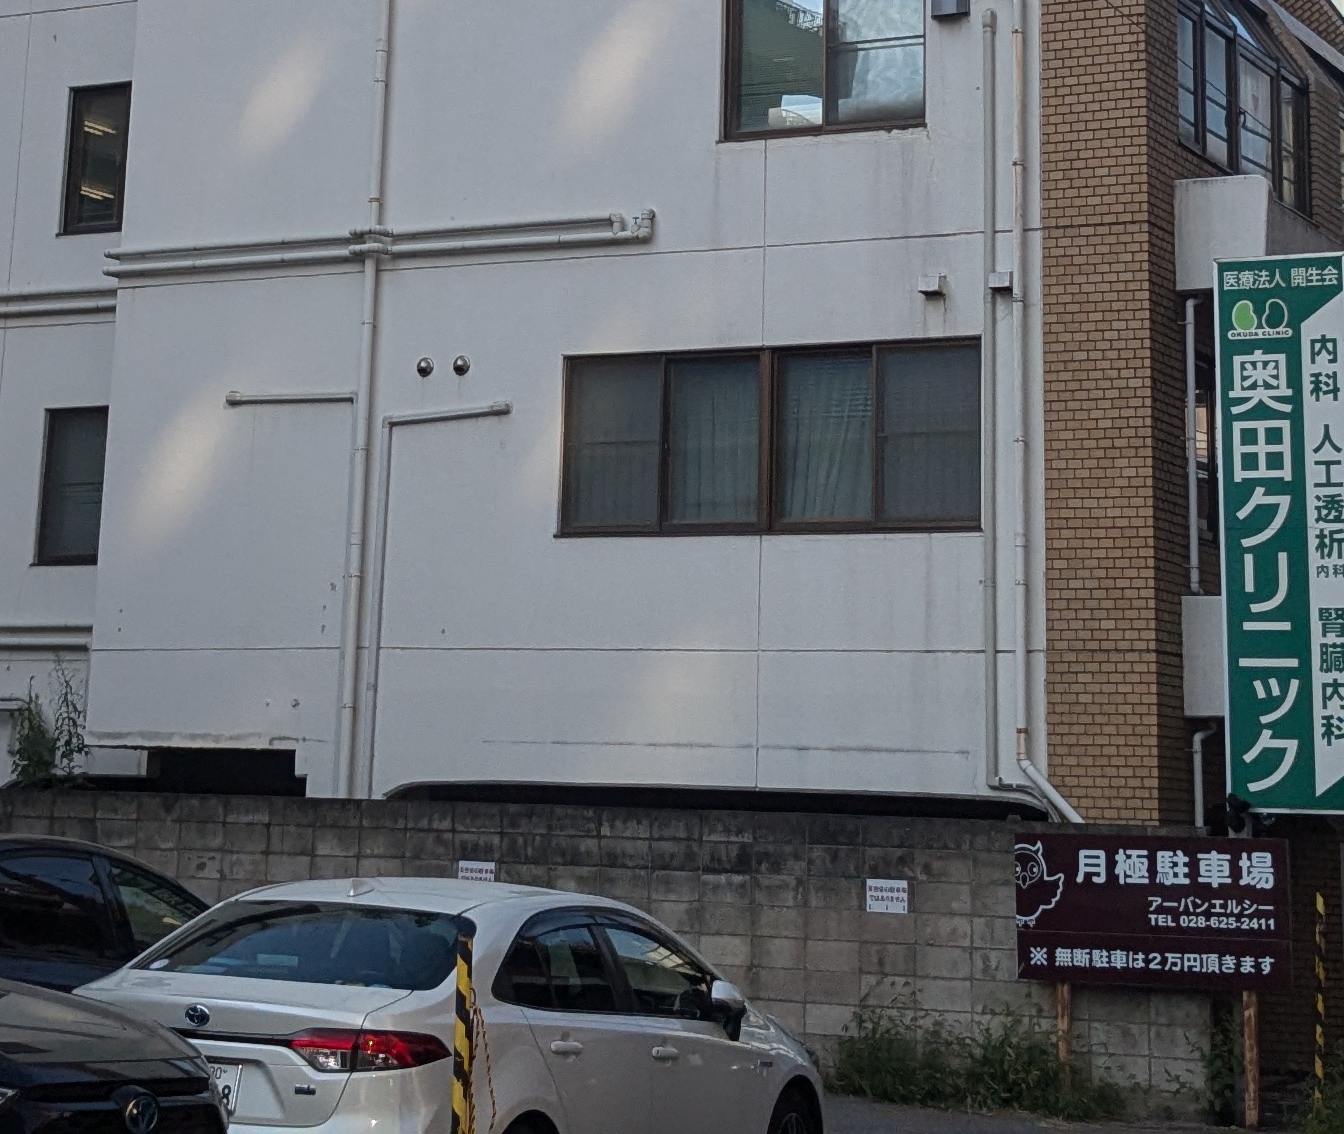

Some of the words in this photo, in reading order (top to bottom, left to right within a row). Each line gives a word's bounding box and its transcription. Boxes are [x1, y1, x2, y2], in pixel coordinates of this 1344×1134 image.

[1223, 269, 1286, 290] 医療法人
[1290, 265, 1339, 287] 開生会
[1261, 329, 1290, 337] CLINIC
[1309, 334, 1340, 403] 内科
[1228, 349, 1299, 792] 奥田クリニック
[1076, 848, 1275, 890] 月極駐車場
[1147, 896, 1275, 914] アーバンエルシー
[1149, 914, 1176, 927] TEL
[1179, 915, 1275, 930] 028-625-2411
